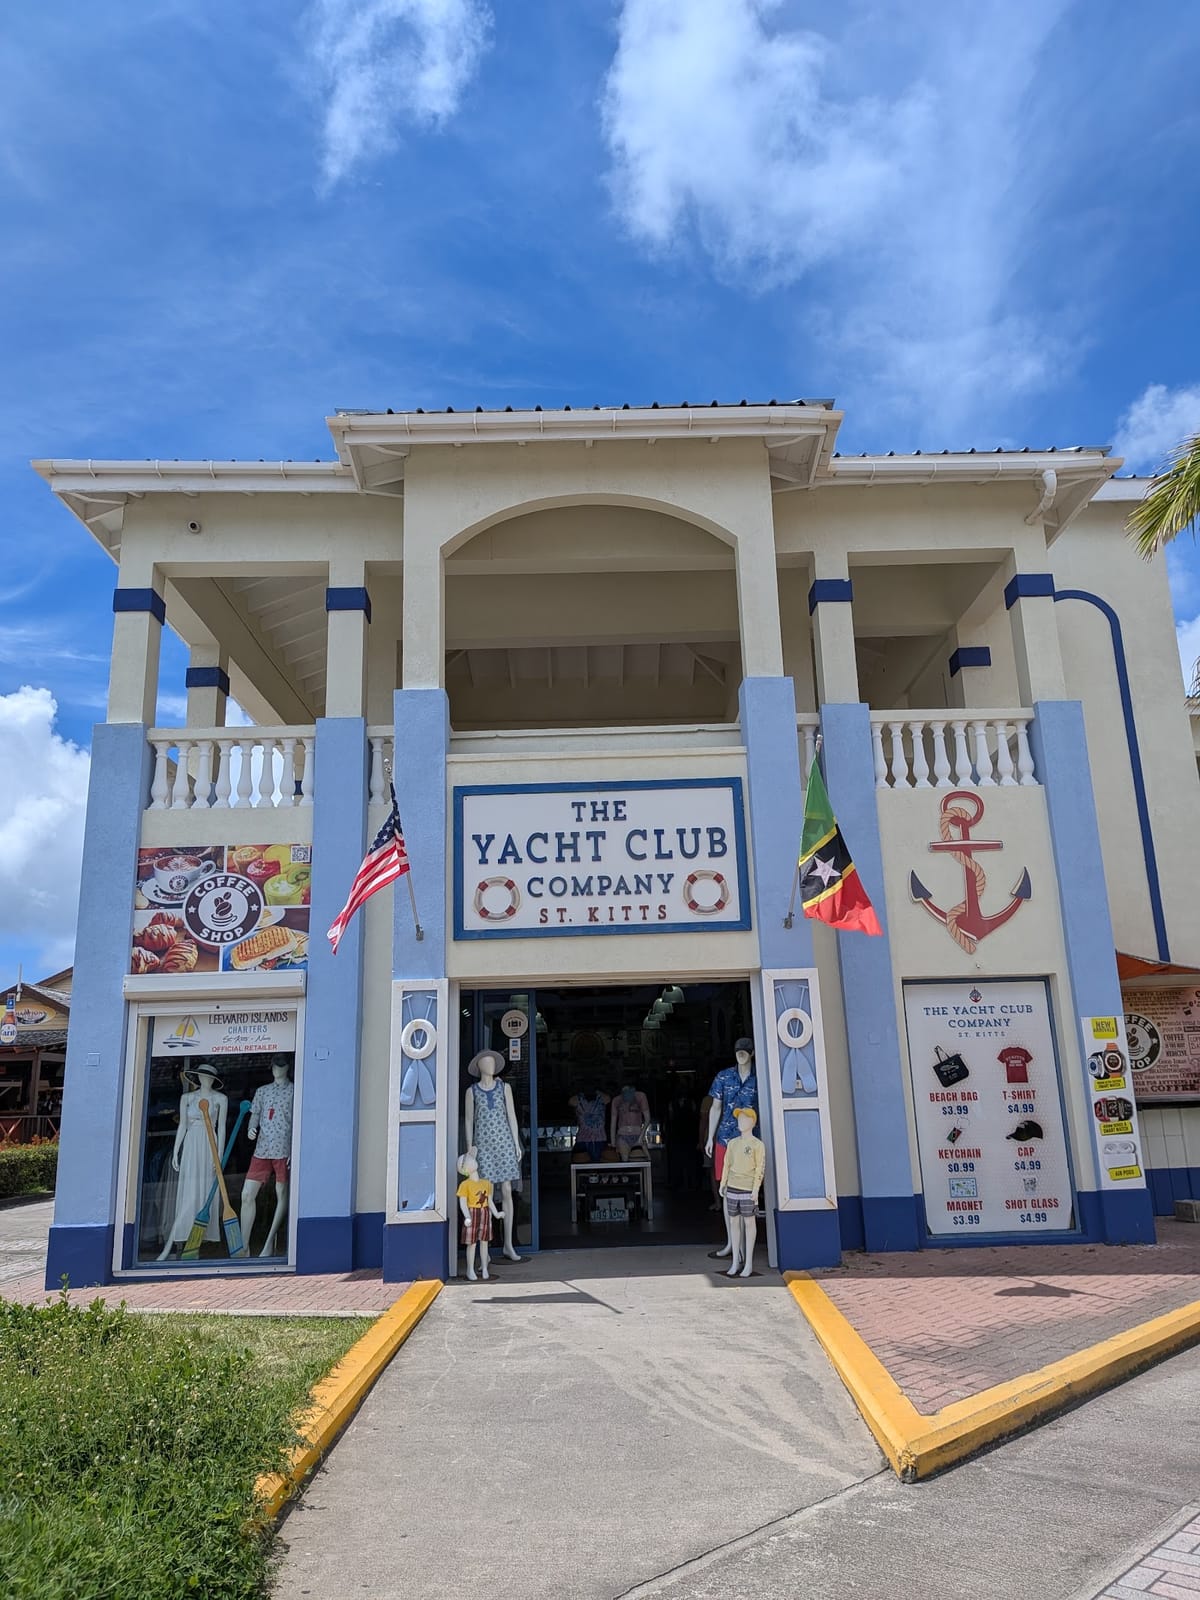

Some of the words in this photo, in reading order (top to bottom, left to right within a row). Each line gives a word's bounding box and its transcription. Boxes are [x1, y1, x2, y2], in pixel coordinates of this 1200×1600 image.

[571, 800, 627, 822] THE
[472, 830, 606, 864] YACHT
[625, 827, 728, 860] CLUB
[194, 876, 255, 897] COFFEE
[527, 873, 674, 898] COMPANY
[539, 907, 573, 923] ST.
[588, 905, 667, 923] KITTS
[200, 927, 244, 941] SHOP
[923, 1007, 948, 1016] THE
[952, 1005, 995, 1015] YACHT
[1000, 1004, 1033, 1014] CLUB
[209, 1013, 249, 1024] LEEWARD
[251, 1011, 288, 1023] ISLANDS
[948, 1018, 1011, 1028] COMPANY
[228, 1025, 268, 1034] CHARTERS
[1095, 1020, 1111, 1028] NEW
[1124, 1017, 1153, 1032] FFEE
[1130, 1056, 1151, 1068] HOP
[929, 1092, 958, 1102] BEACH
[961, 1091, 978, 1101] BAG
[1002, 1089, 1036, 1100] T-SHIRT
[942, 1105, 969, 1115] $3.99
[1008, 1104, 1034, 1113] $4.99
[938, 1149, 981, 1159] KEYCHAIN
[1017, 1147, 1035, 1157] CAP
[948, 1162, 975, 1173] $0.99
[1014, 1160, 1041, 1171] $4.99
[947, 1201, 983, 1211] MAGNET
[1005, 1199, 1028, 1210] SHOT
[1031, 1198, 1059, 1209] GLASS
[953, 1215, 980, 1225] $3.99
[1020, 1213, 1047, 1223] $4.99
